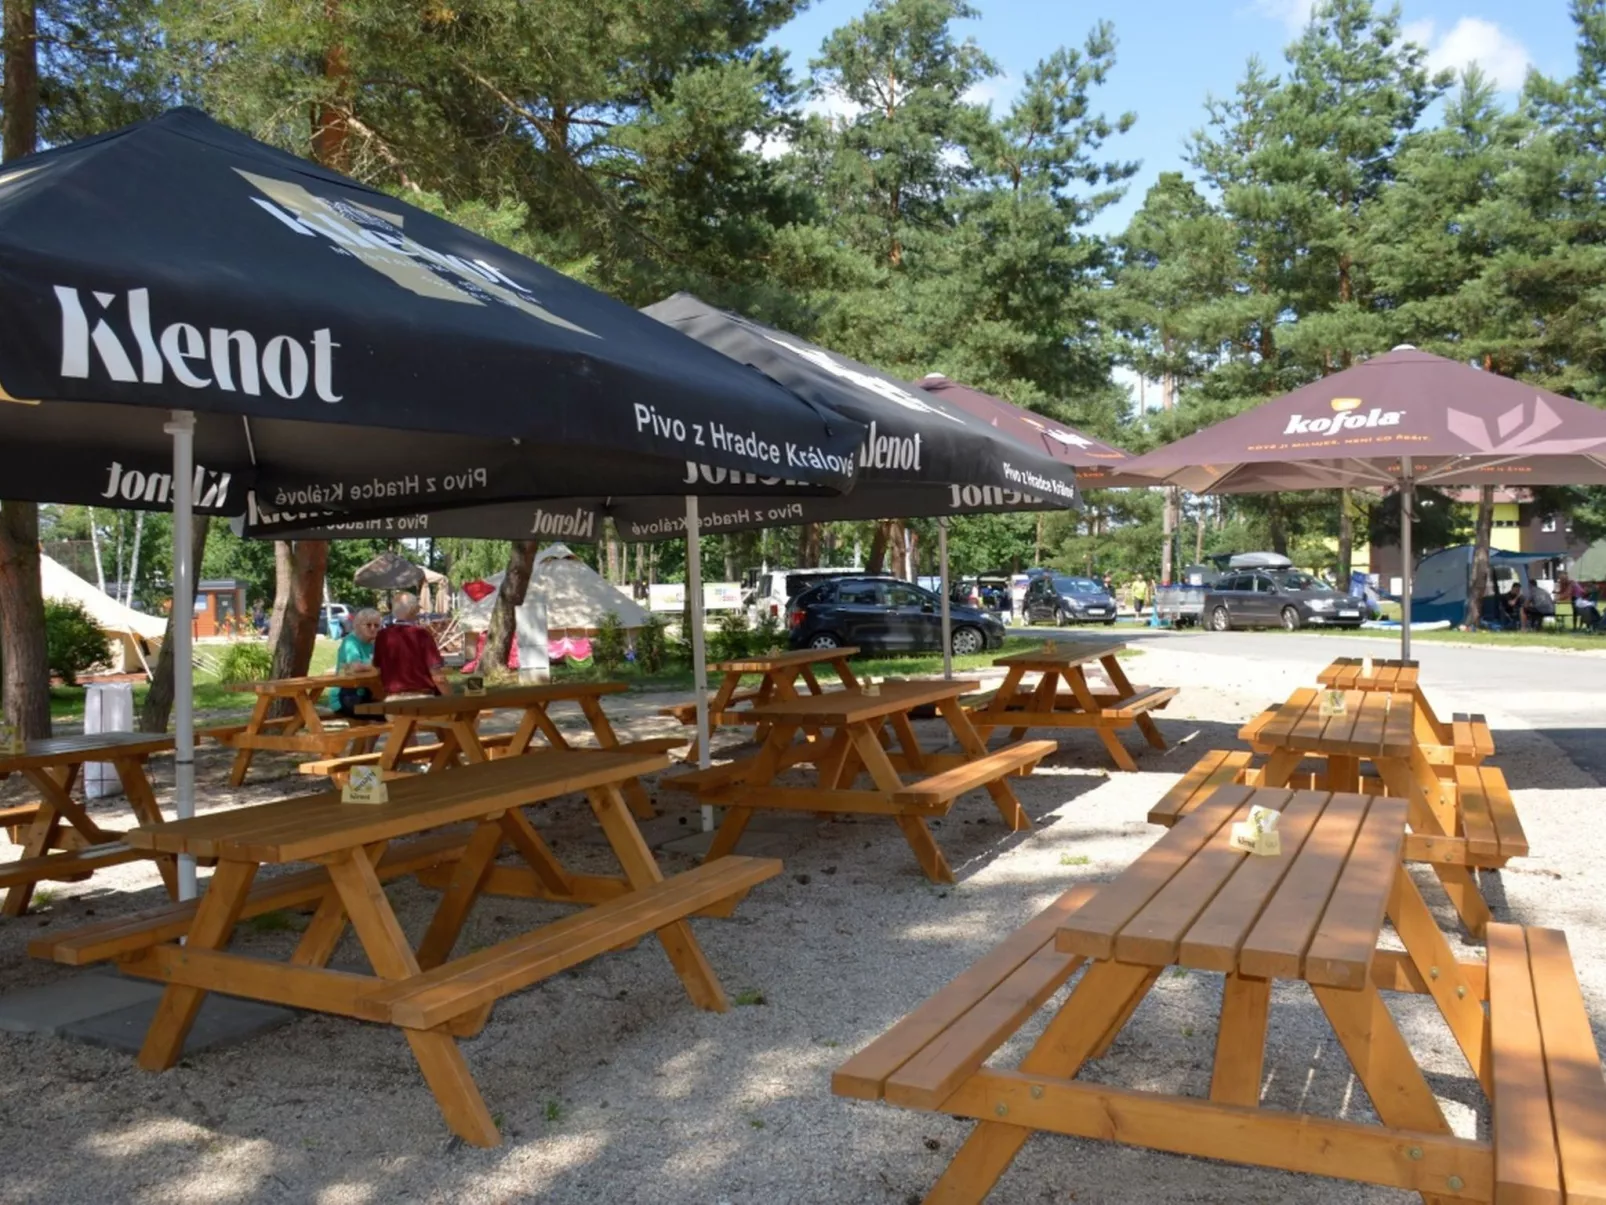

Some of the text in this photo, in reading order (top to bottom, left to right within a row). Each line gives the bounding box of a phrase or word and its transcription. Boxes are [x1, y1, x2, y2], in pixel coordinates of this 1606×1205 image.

[53, 285, 343, 403] Klenot
[633, 402, 855, 478] Pivo z Hradce Králové
[1283, 408, 1402, 436] kofola
